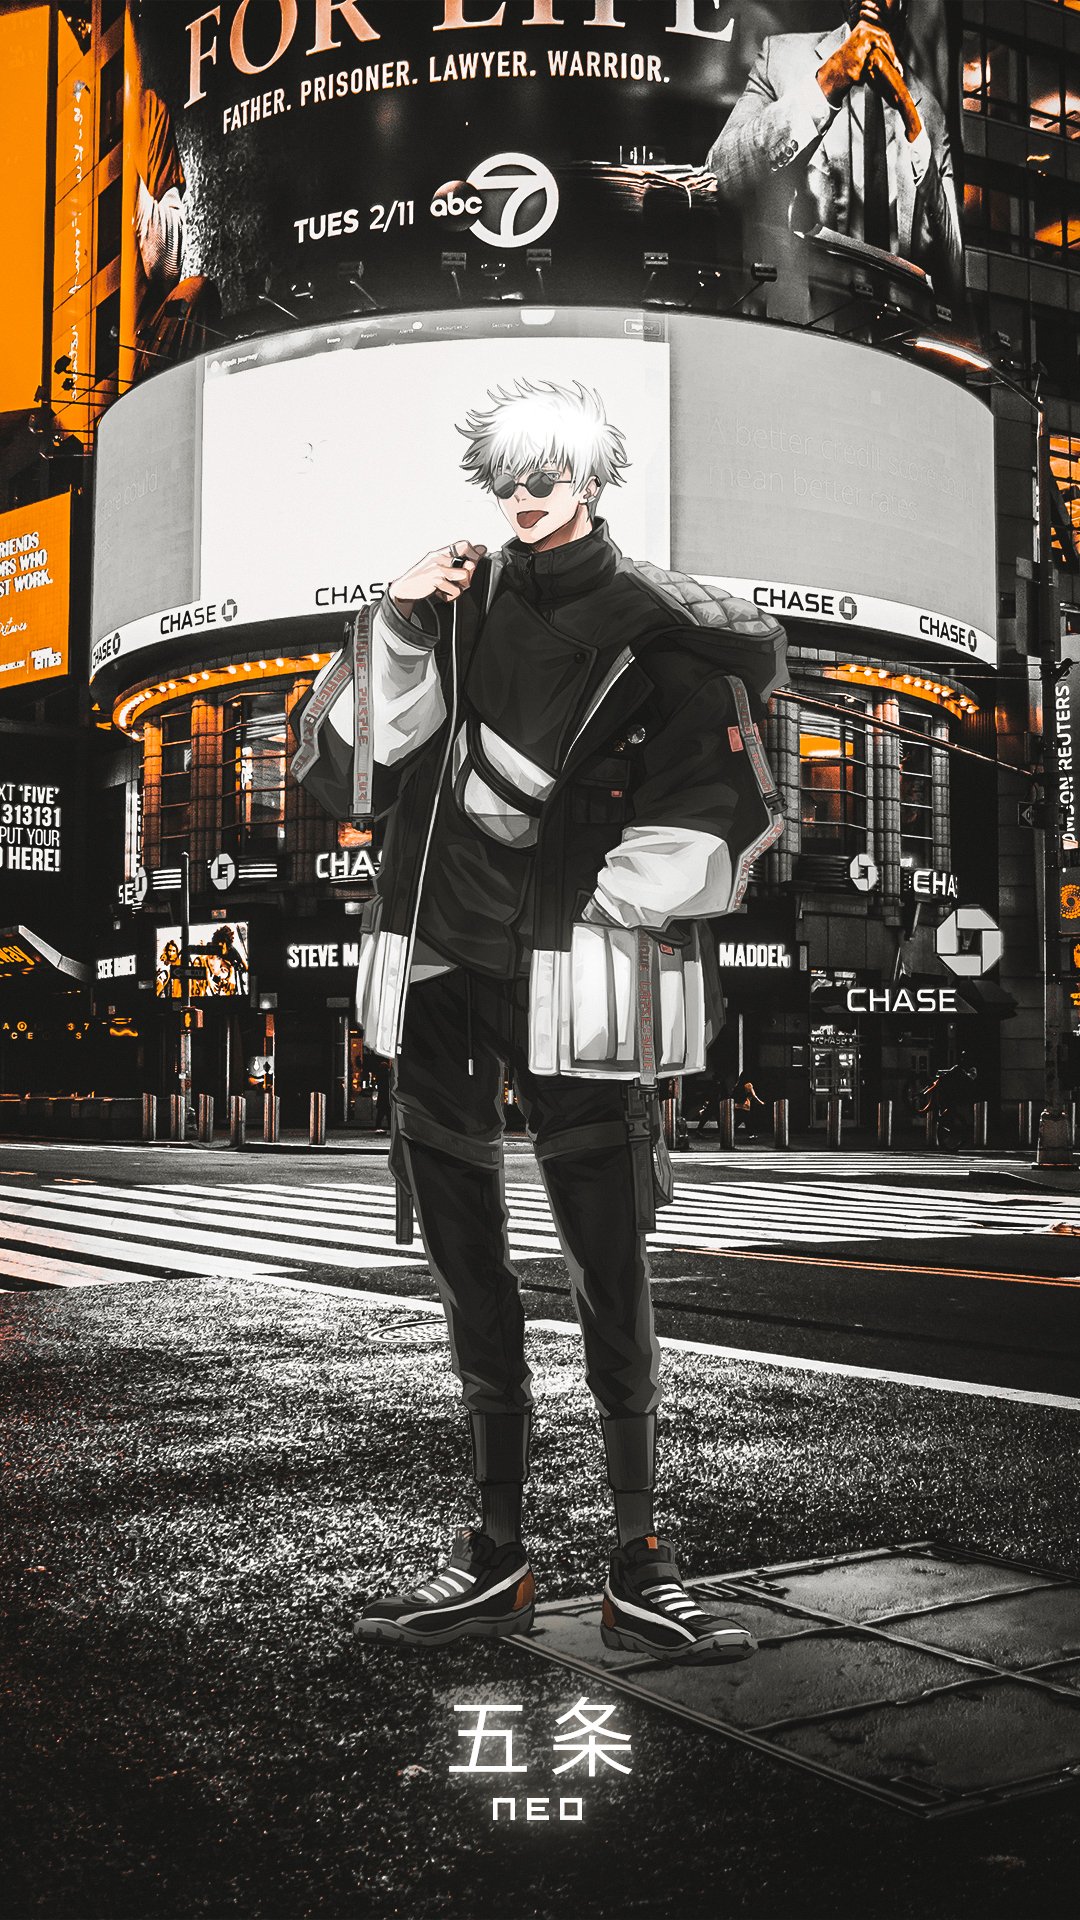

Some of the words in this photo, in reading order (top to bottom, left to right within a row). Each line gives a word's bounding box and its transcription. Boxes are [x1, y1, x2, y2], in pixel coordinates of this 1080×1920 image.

[183, 0, 381, 109] FOR
[223, 88, 292, 134] FATHER.
[300, 60, 418, 107] PRISONER.
[429, 51, 537, 82] LAWYER.
[547, 50, 670, 83] WARRIOR.
[293, 209, 359, 243] TUES
[369, 200, 414, 232] 2/11
[430, 191, 483, 217] abc
[735, 418, 813, 456] better
[793, 468, 862, 506] better
[20, 548, 48, 571] WHO
[14, 568, 53, 593] WORK.
[315, 581, 393, 606] CHAS
[753, 587, 835, 616] CHASE
[160, 604, 217, 635] CHASE
[919, 615, 967, 648] CHASE
[1055, 684, 1073, 771] REUTERS
[2, 803, 61, 828] 313131
[27, 828, 60, 848] YOUR
[7, 846, 61, 873] HERE!
[287, 943, 339, 968] STEVE
[343, 943, 360, 967] M
[846, 988, 958, 1012] CHASE
